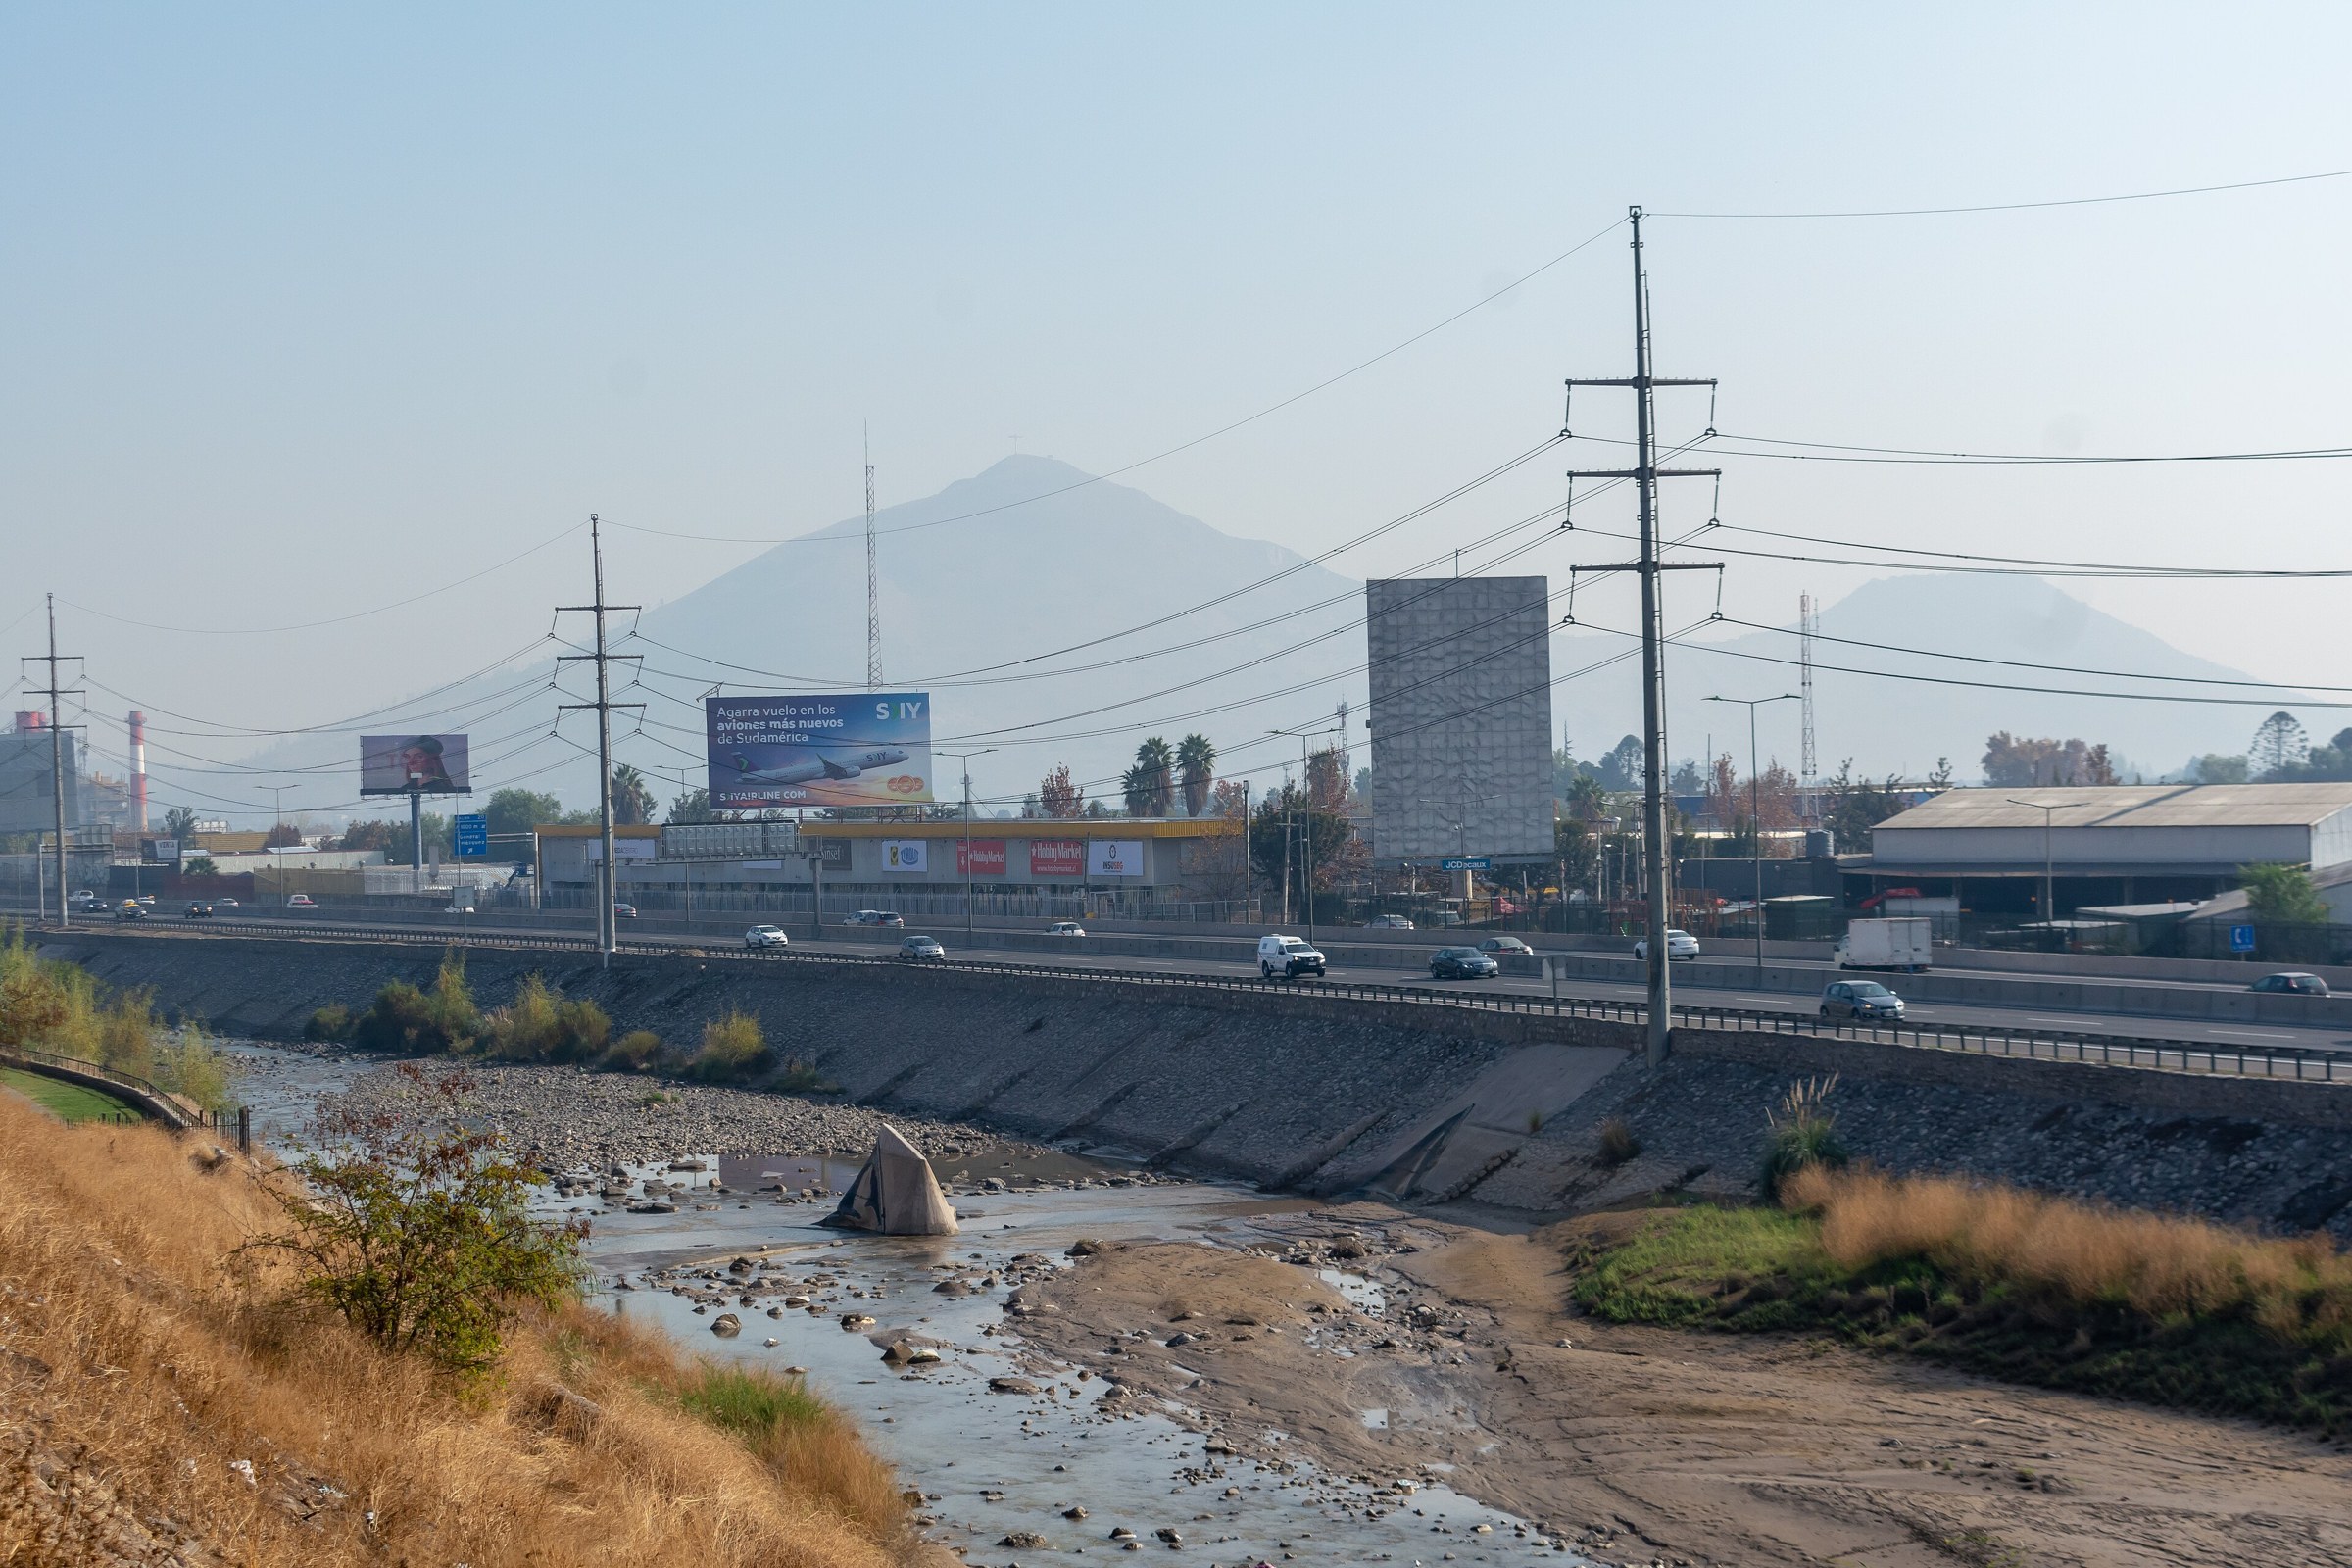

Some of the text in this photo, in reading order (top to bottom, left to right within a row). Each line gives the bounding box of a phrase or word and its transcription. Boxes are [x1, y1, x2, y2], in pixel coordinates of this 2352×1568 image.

[717, 704, 836, 719] Agarra vuelo en los
[717, 718, 844, 731] aviones más nuevos
[717, 731, 808, 744] de Sudamérica
[973, 850, 1004, 864] Hobby Market
[1038, 842, 1082, 862] Hobby Market
